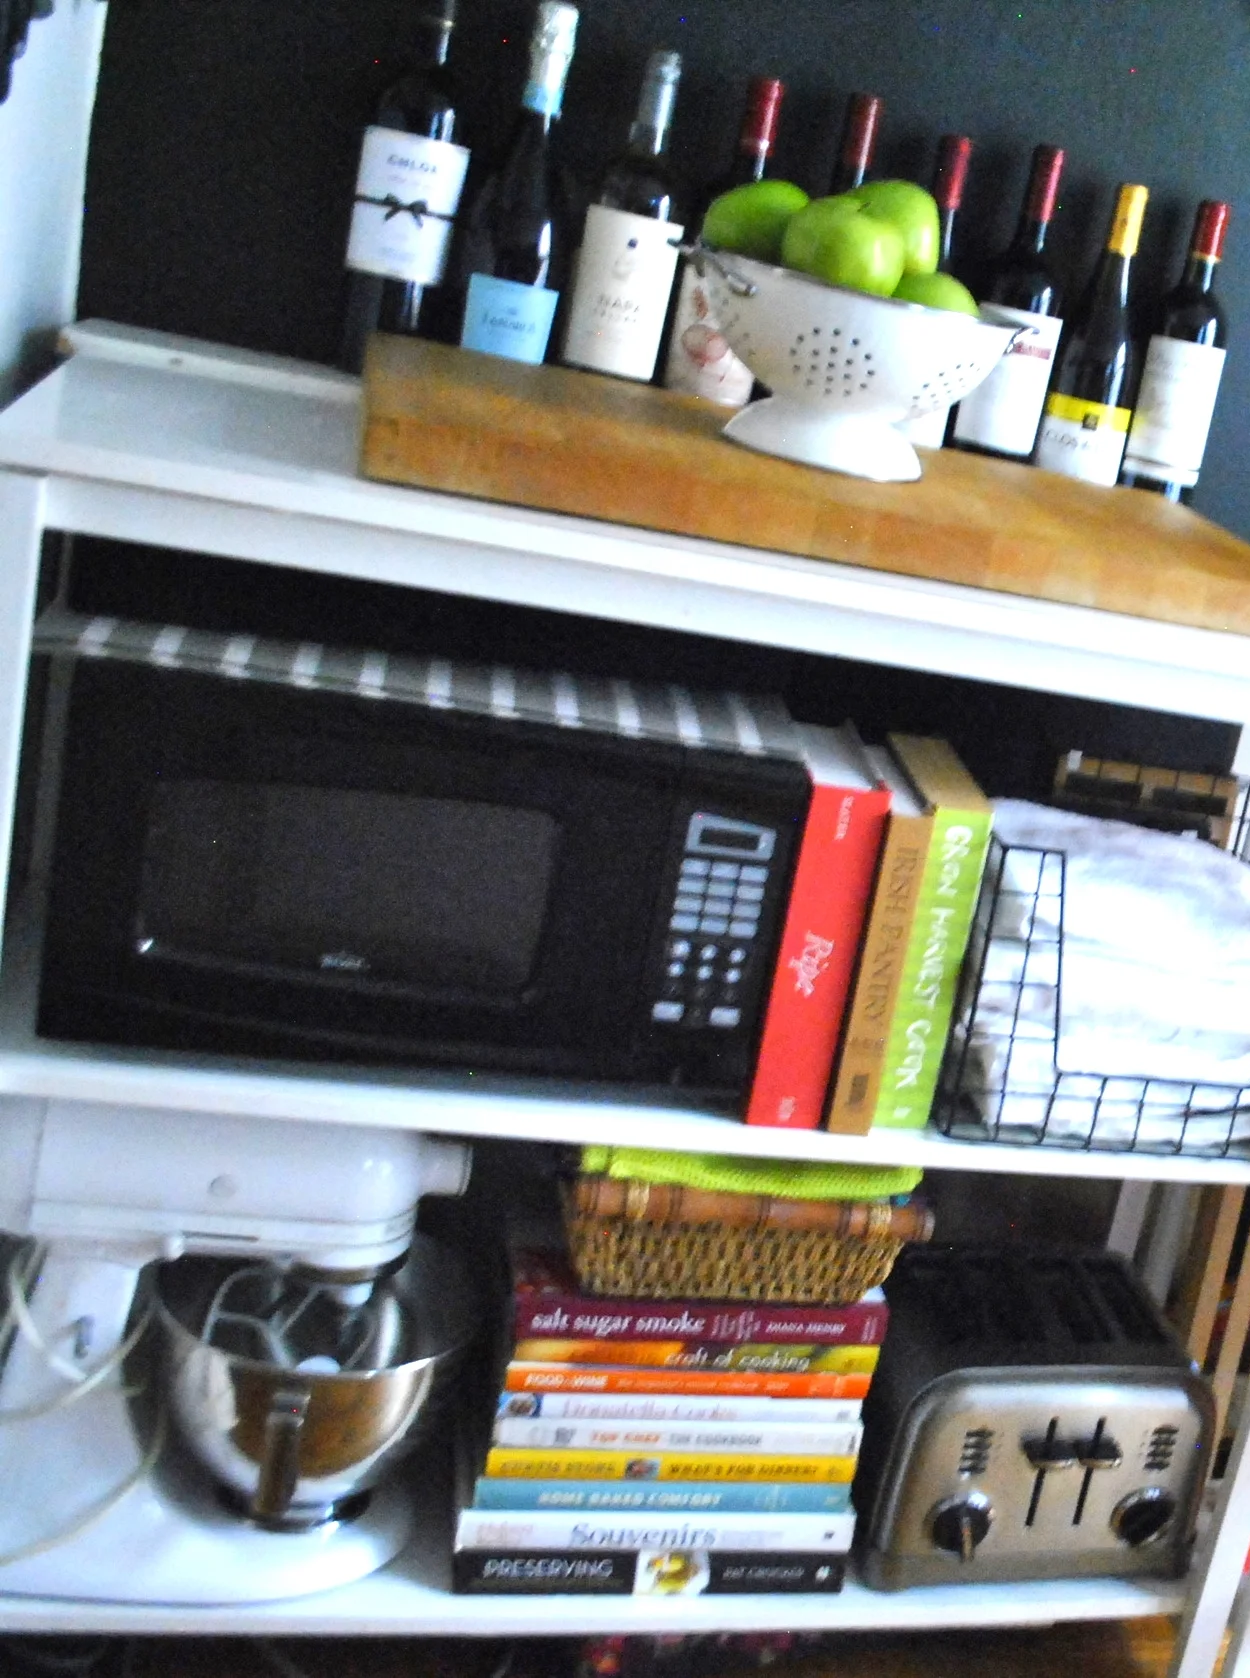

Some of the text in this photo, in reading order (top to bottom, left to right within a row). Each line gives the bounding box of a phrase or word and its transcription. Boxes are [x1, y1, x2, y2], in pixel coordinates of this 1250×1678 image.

[884, 847, 919, 914] IRISH
[863, 922, 905, 1023] PANTRY
[530, 1306, 572, 1332] salt
[573, 1313, 634, 1338] sugar
[635, 1310, 707, 1334] smoke
[713, 1348, 735, 1369] of
[737, 1350, 812, 1373] cooking
[568, 1522, 718, 1547] Souvenirs
[483, 1557, 614, 1579] PRESERVING
